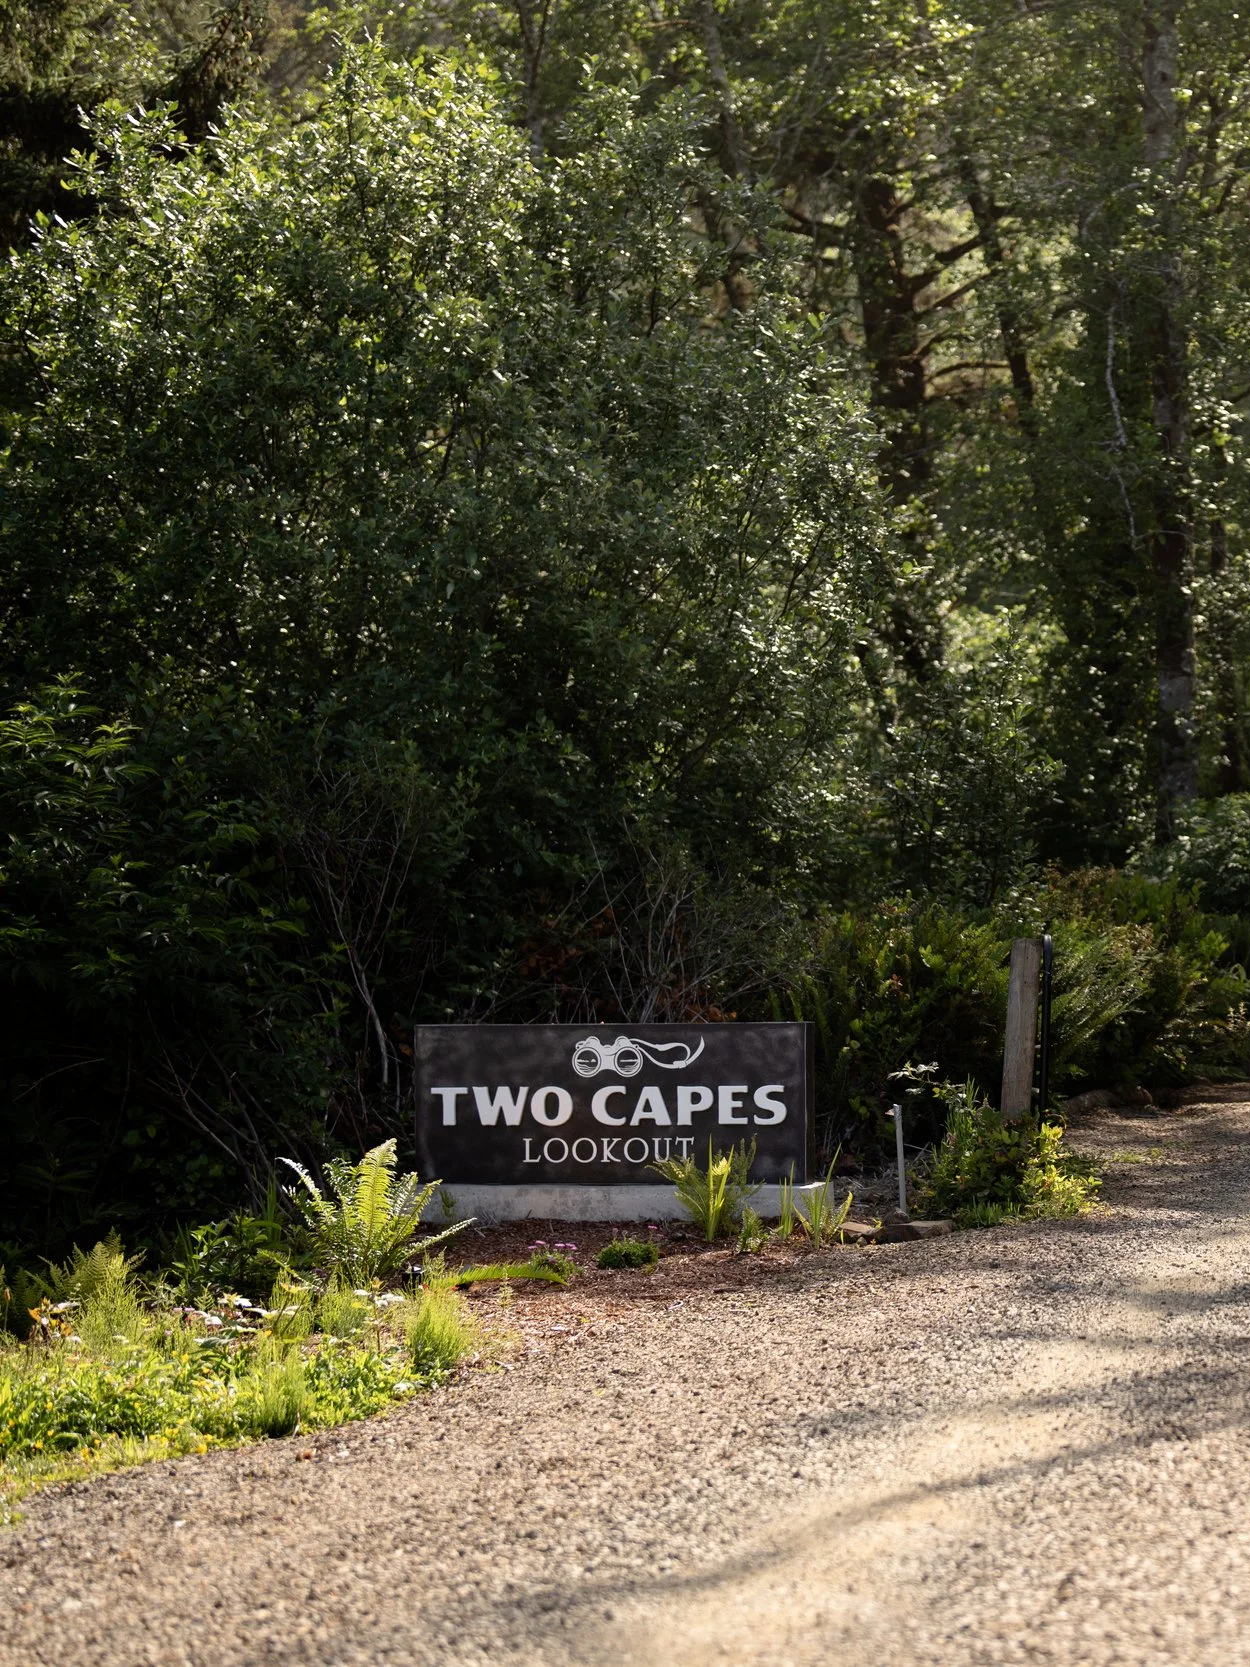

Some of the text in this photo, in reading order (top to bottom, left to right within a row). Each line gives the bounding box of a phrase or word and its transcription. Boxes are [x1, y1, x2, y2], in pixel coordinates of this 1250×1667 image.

[430, 1084, 788, 1127] TWO CAPES
[522, 1136, 695, 1163] LOOKOUT
